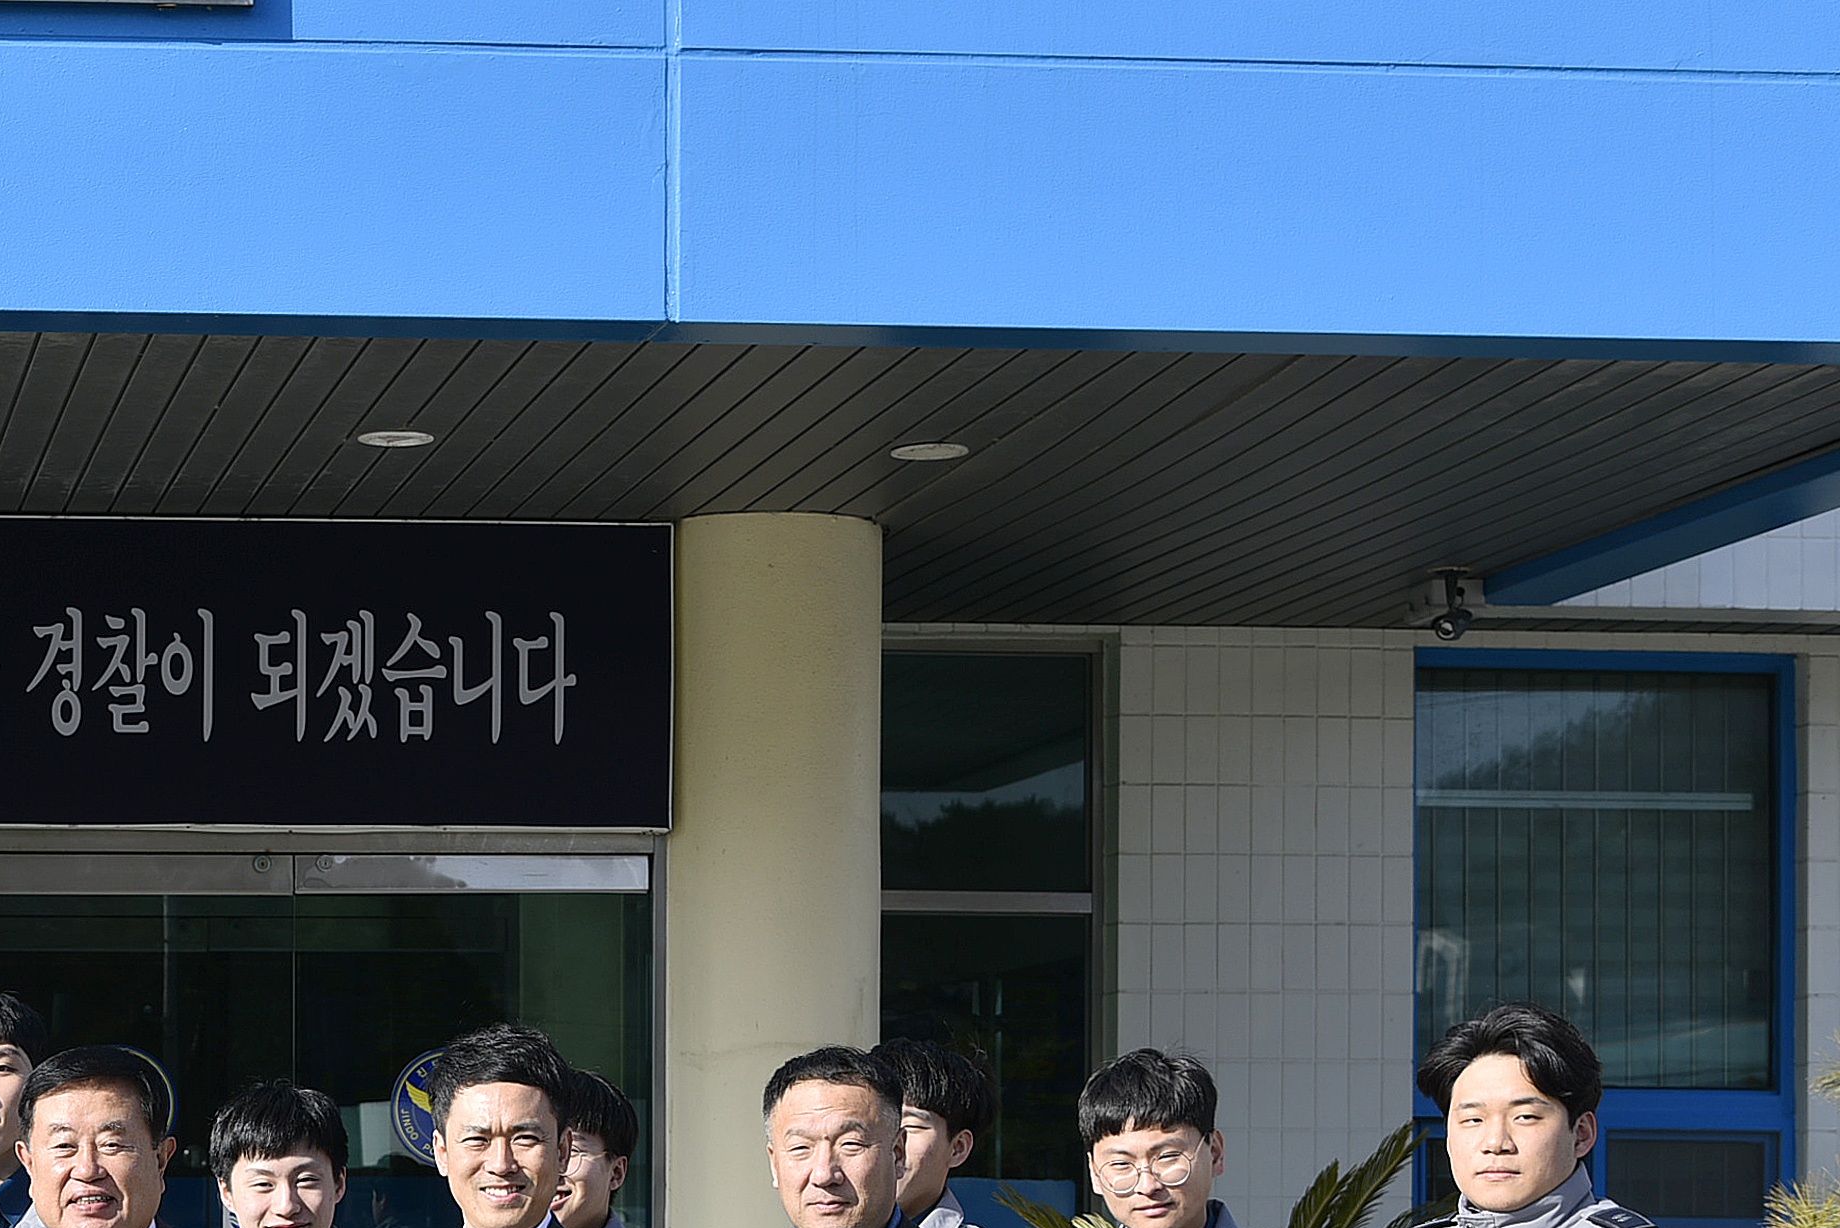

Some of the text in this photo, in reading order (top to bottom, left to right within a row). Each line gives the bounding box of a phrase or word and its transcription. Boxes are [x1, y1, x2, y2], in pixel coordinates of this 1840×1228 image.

[26, 606, 214, 743] 경찰이
[250, 609, 577, 745] 되겠습니다
[401, 1108, 420, 1141] JINDO
